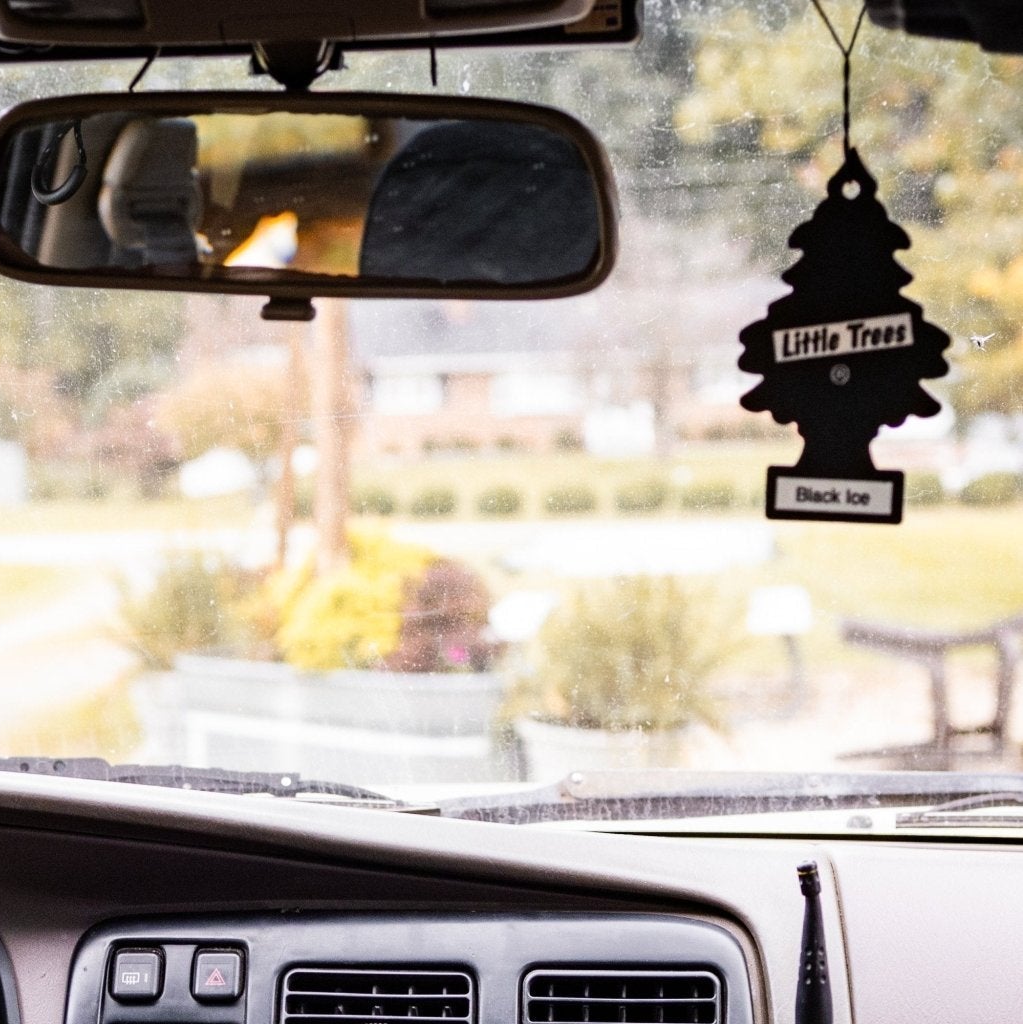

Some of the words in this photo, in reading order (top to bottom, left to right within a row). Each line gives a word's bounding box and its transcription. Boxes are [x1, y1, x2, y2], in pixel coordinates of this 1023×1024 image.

[782, 327, 840, 358] Little
[847, 322, 907, 349] Trees
[795, 486, 841, 504] Black
[846, 489, 871, 506] Ice
